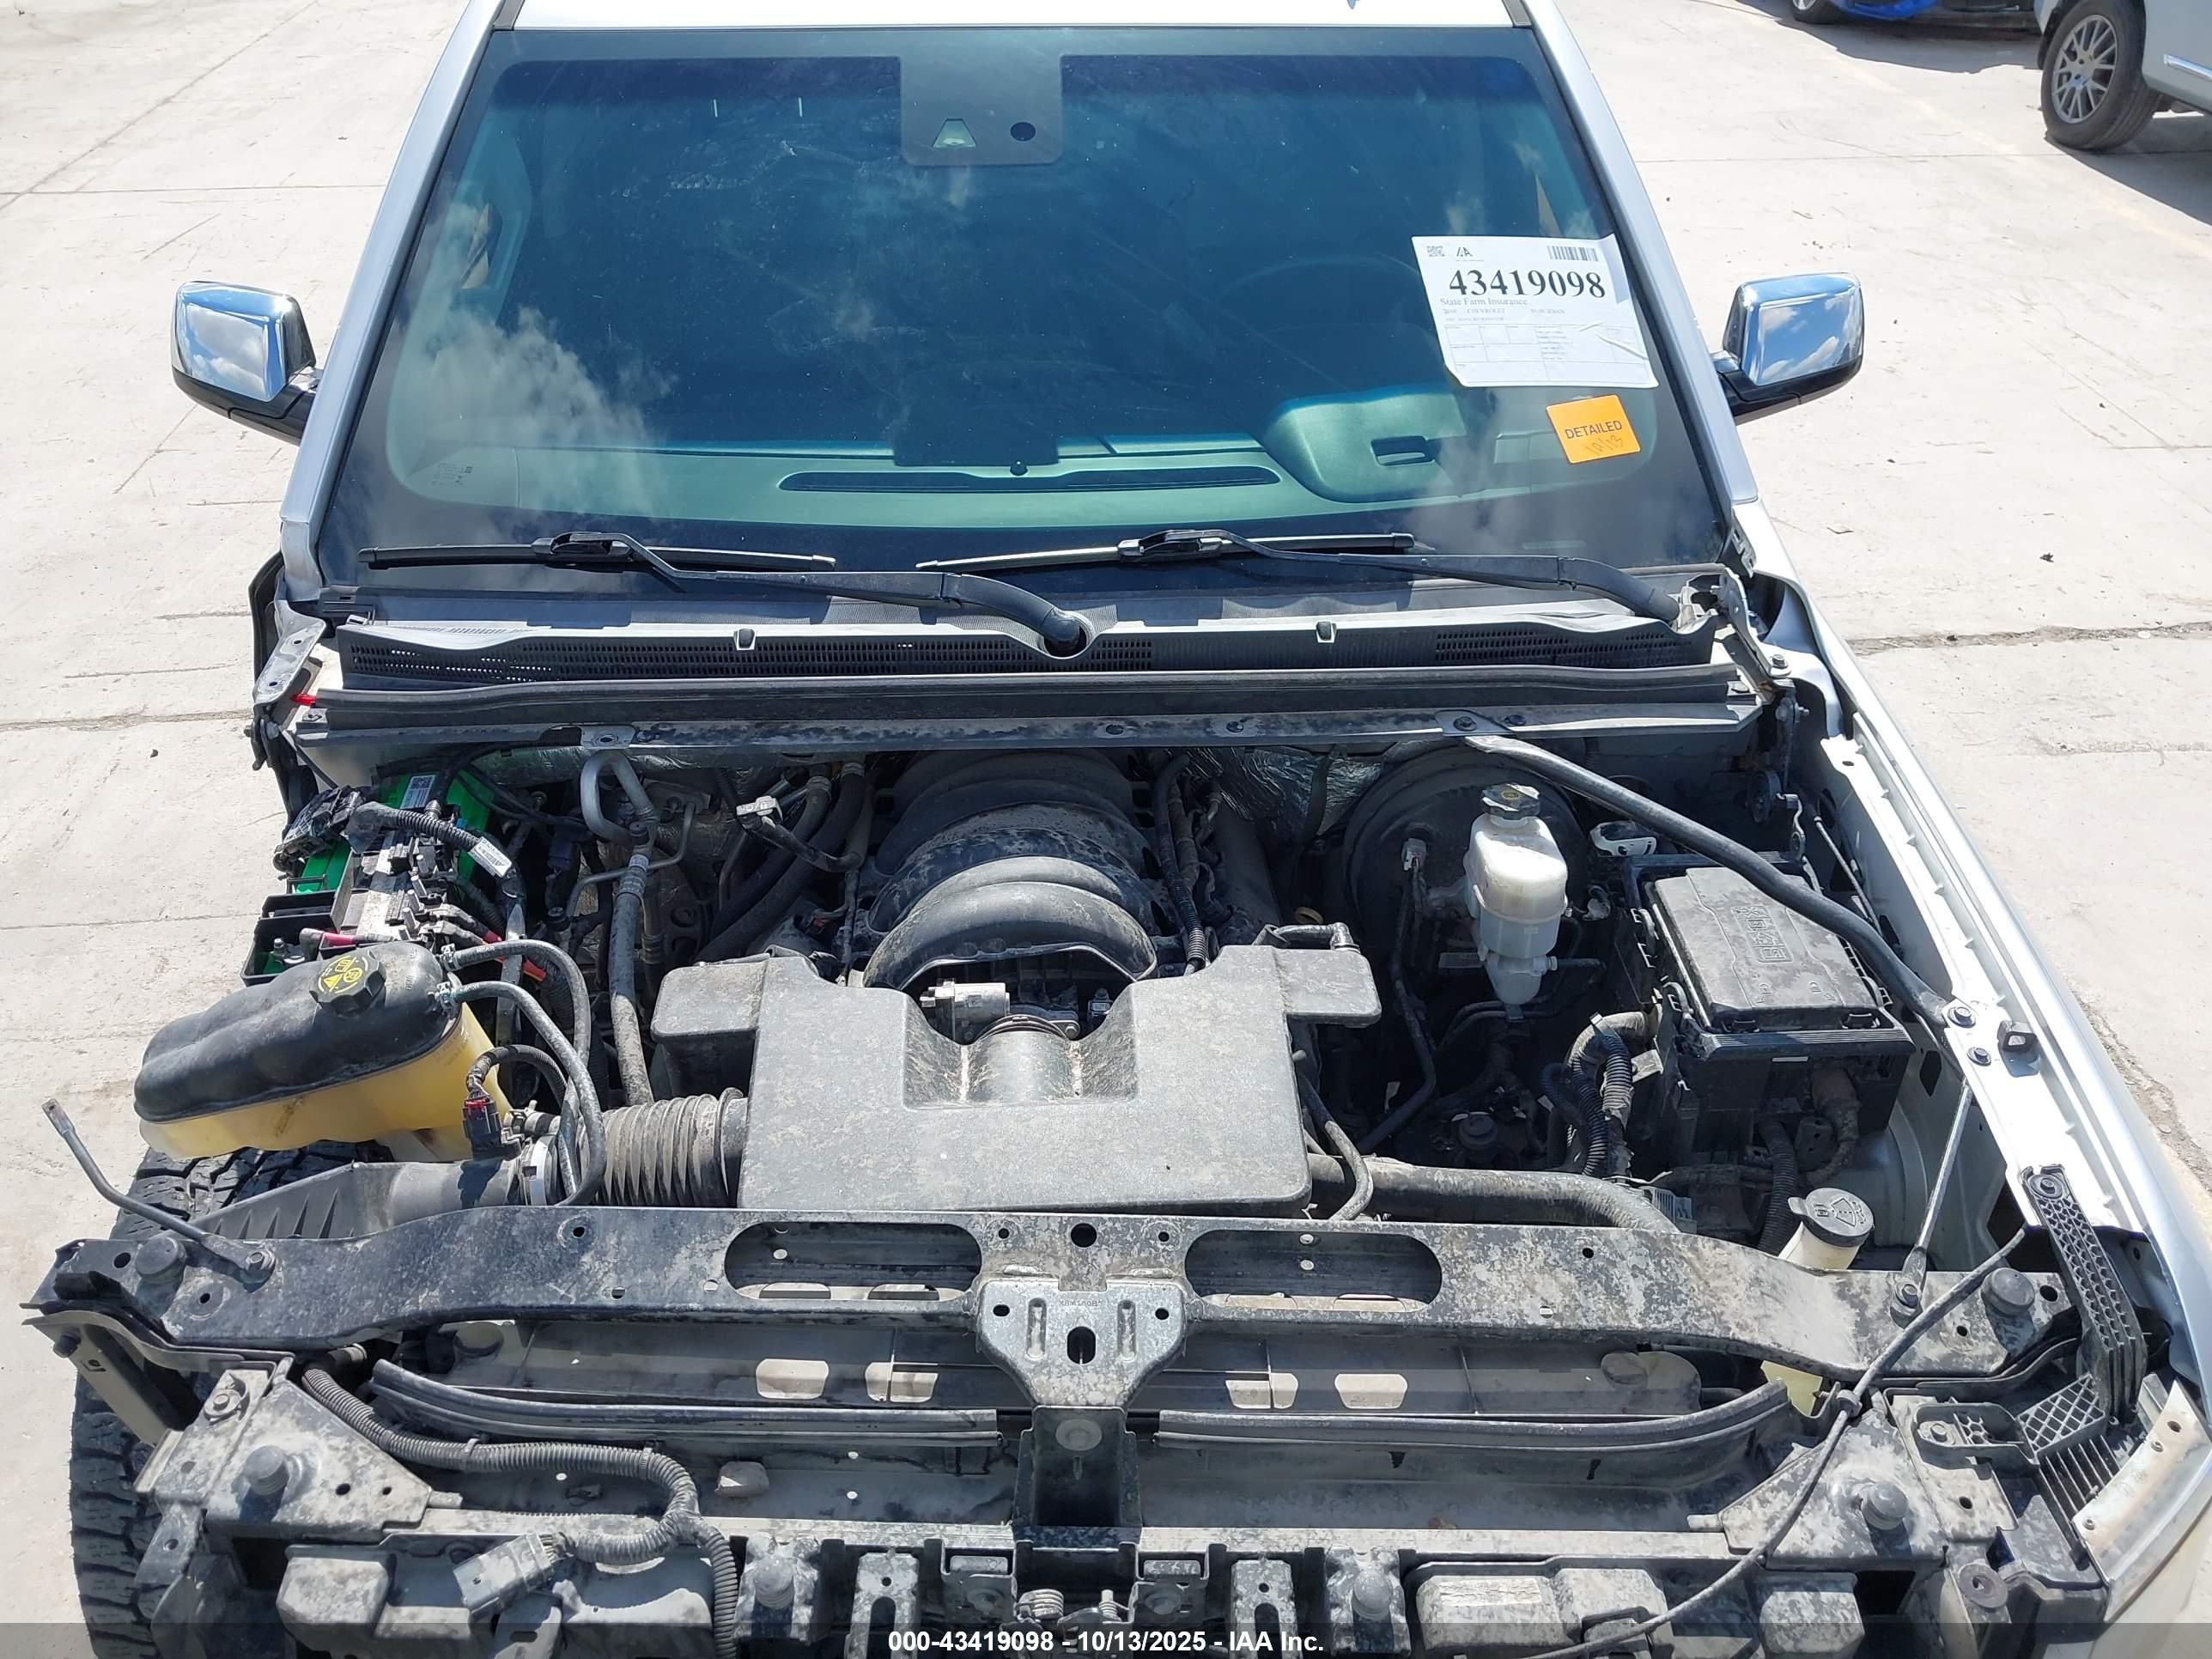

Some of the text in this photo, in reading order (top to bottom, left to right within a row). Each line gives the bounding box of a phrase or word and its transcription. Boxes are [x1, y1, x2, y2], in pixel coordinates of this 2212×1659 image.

[1449, 269, 1606, 298] 43419098
[1440, 297, 1528, 306] State Farm Insurance
[1565, 420, 1622, 440] DETAILED
